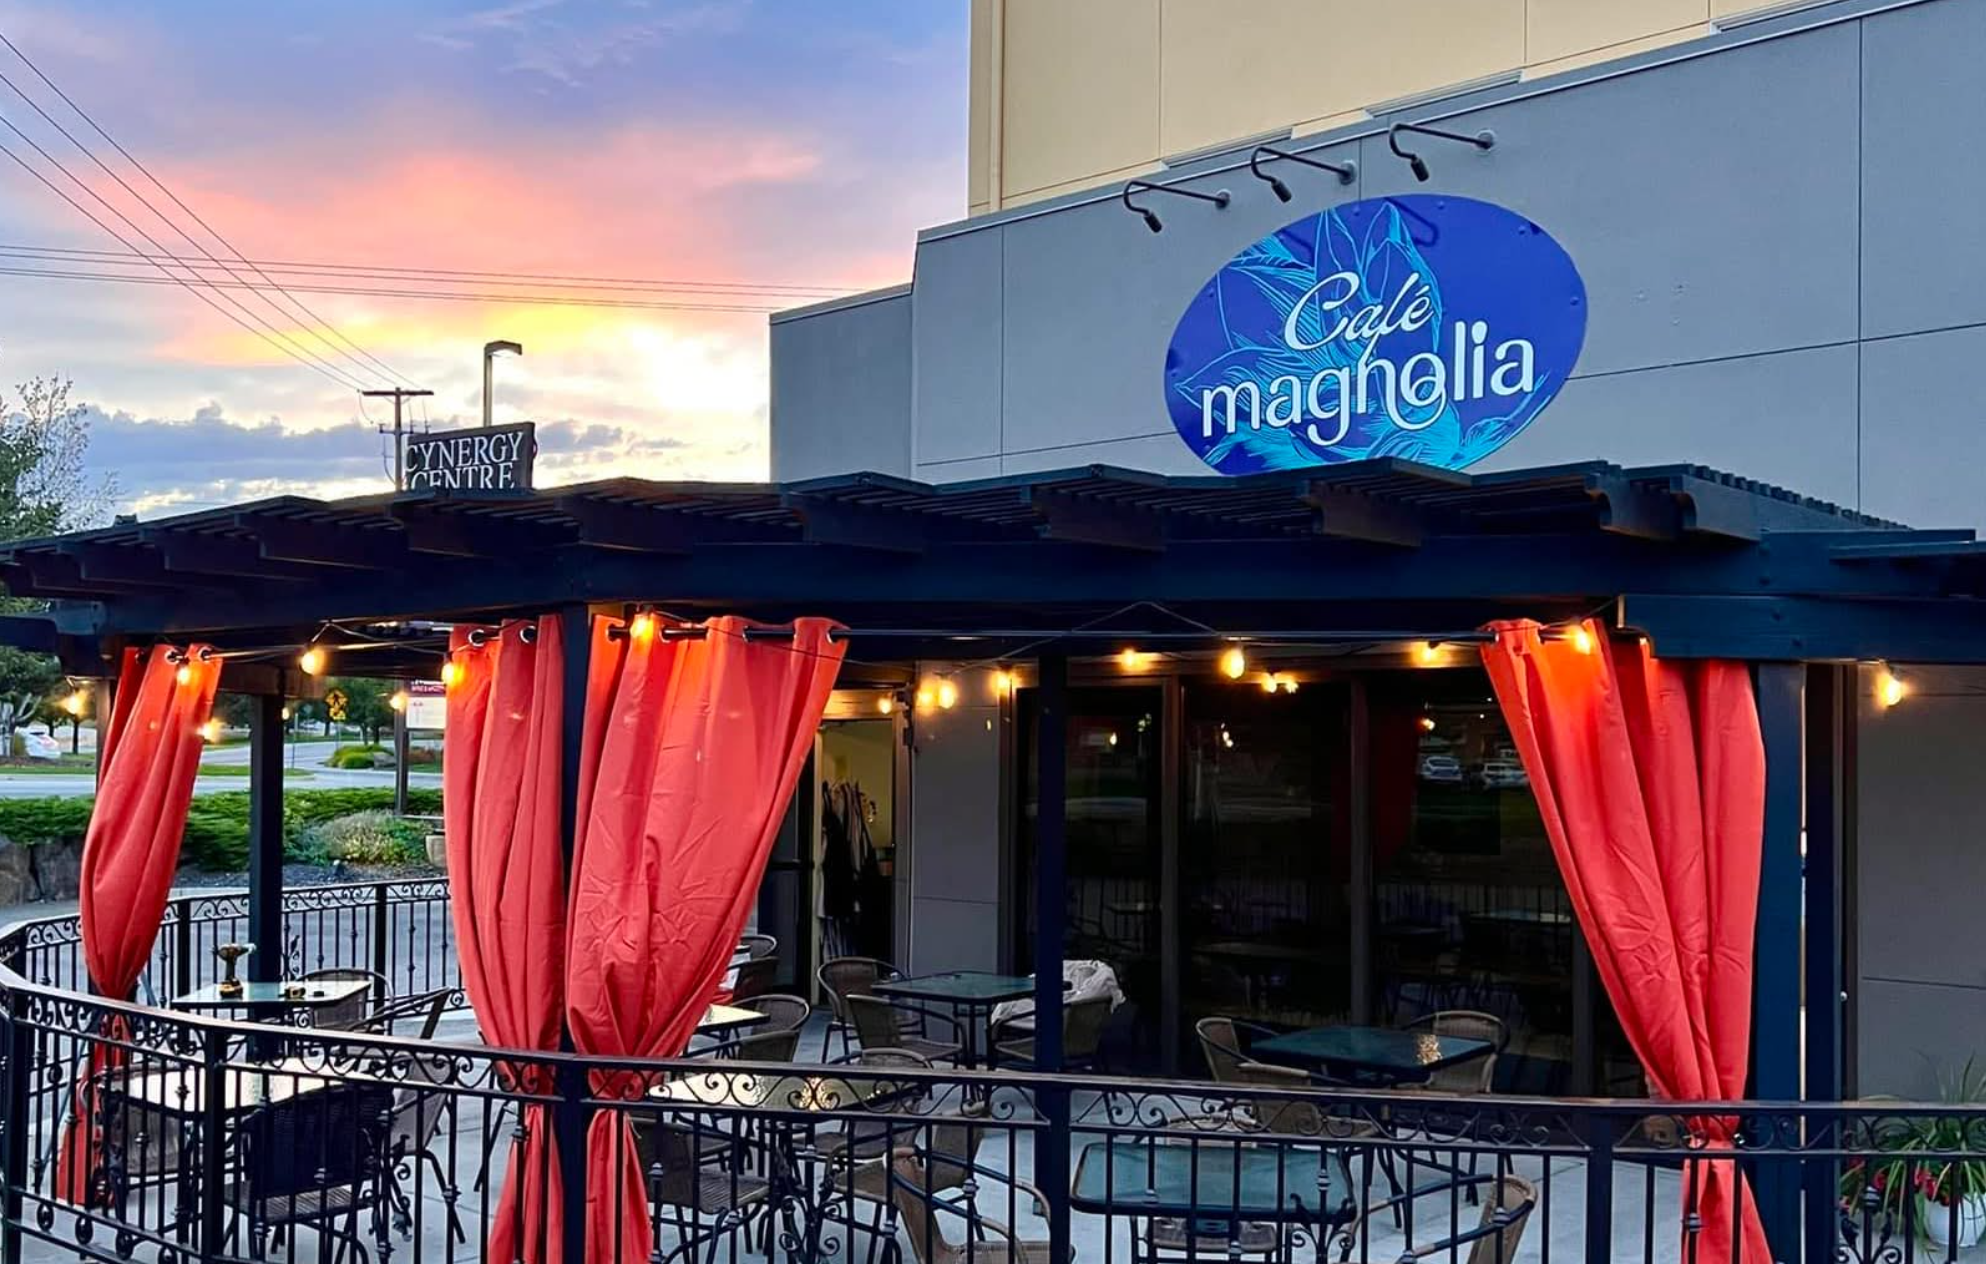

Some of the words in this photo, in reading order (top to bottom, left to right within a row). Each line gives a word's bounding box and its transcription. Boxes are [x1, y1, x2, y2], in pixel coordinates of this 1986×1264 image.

[1284, 271, 1434, 362] Café
[1202, 320, 1535, 447] magnolia
[404, 431, 523, 472] CYNERGY
[410, 462, 515, 490] CENTRE
